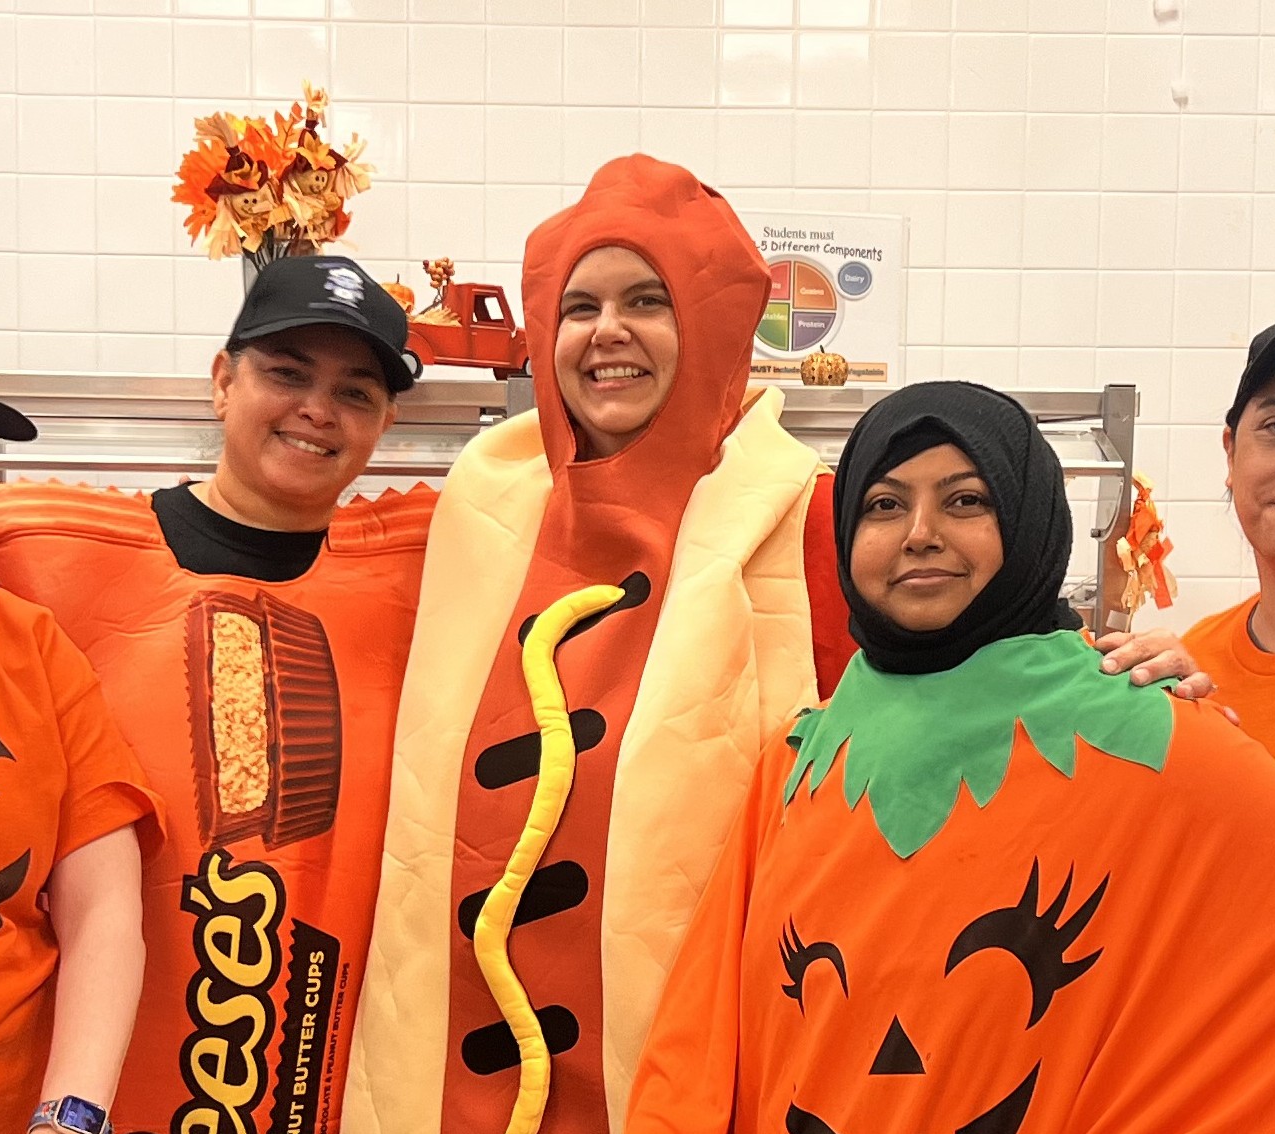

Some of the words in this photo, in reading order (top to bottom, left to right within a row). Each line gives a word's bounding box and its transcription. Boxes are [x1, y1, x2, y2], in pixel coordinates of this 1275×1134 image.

[763, 226, 807, 239] Students
[810, 228, 835, 241] must
[753, 240, 768, 251] -5
[771, 240, 821, 253] Different
[823, 243, 883, 262] Components
[844, 273, 865, 284] Dairy
[797, 320, 826, 330] Protein
[305, 950, 325, 1008] CUPS
[326, 1033, 337, 1074] PEANUT
[332, 991, 345, 1031] BUTTER
[340, 962, 350, 989] CUPS
[294, 1012, 317, 1097] BUTTER
